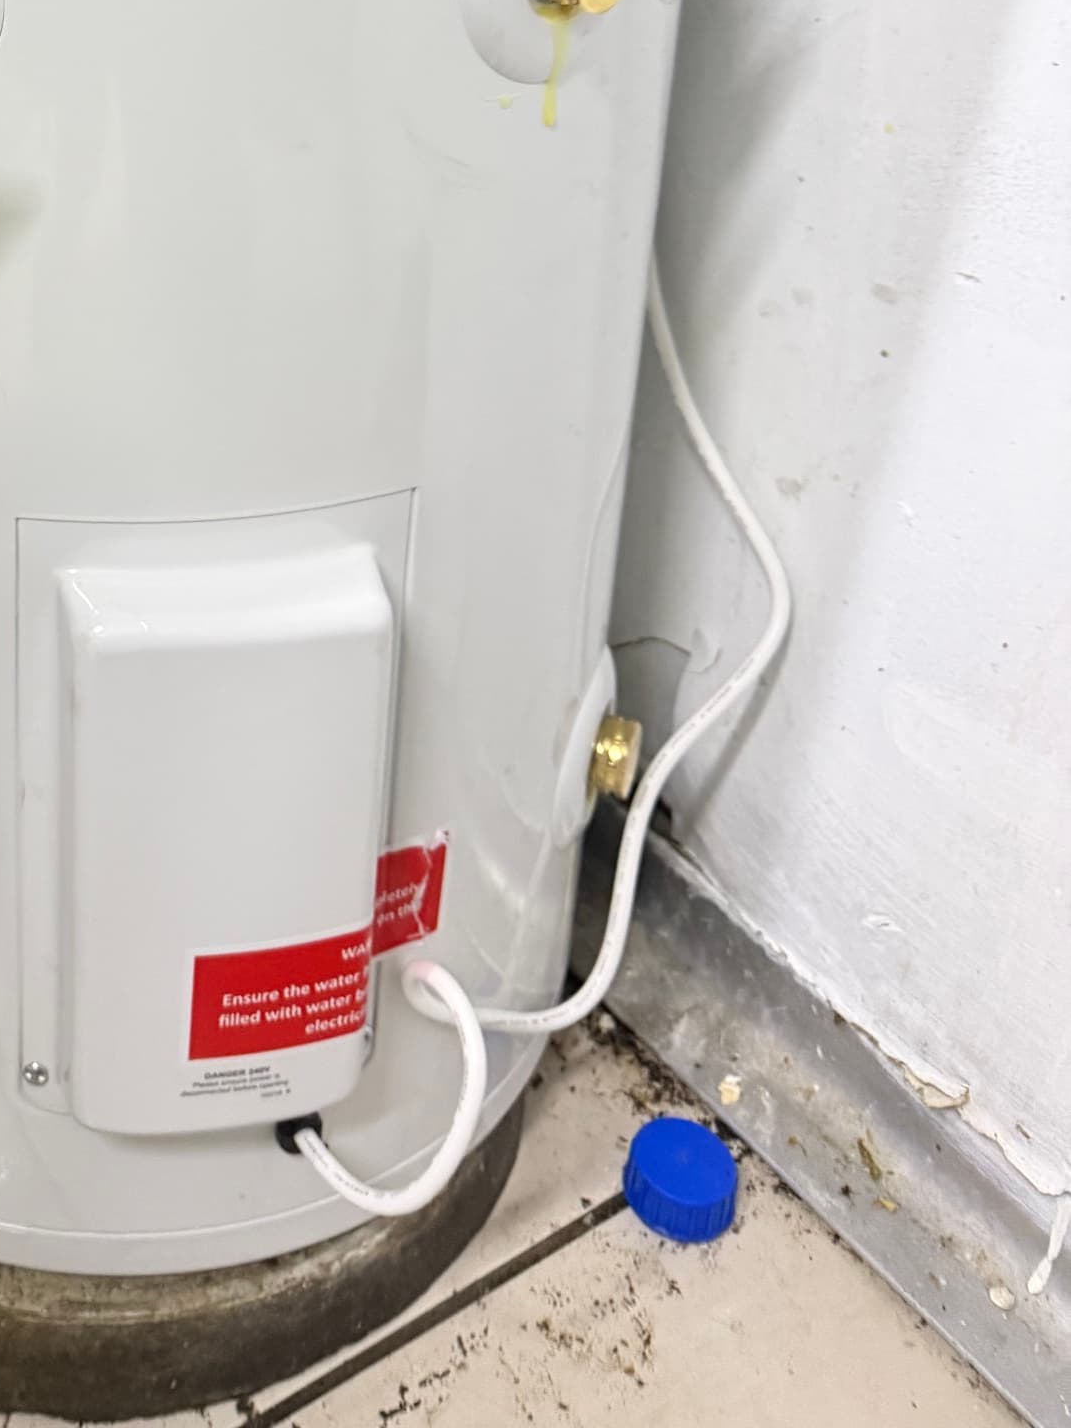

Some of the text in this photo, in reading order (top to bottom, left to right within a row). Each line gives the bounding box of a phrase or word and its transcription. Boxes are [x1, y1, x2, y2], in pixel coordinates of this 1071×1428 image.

[222, 990, 279, 1007] Ensure
[283, 984, 310, 998] the
[314, 972, 360, 993] water
[218, 1010, 261, 1028] filled
[265, 1003, 302, 1022] with
[305, 994, 352, 1014] water
